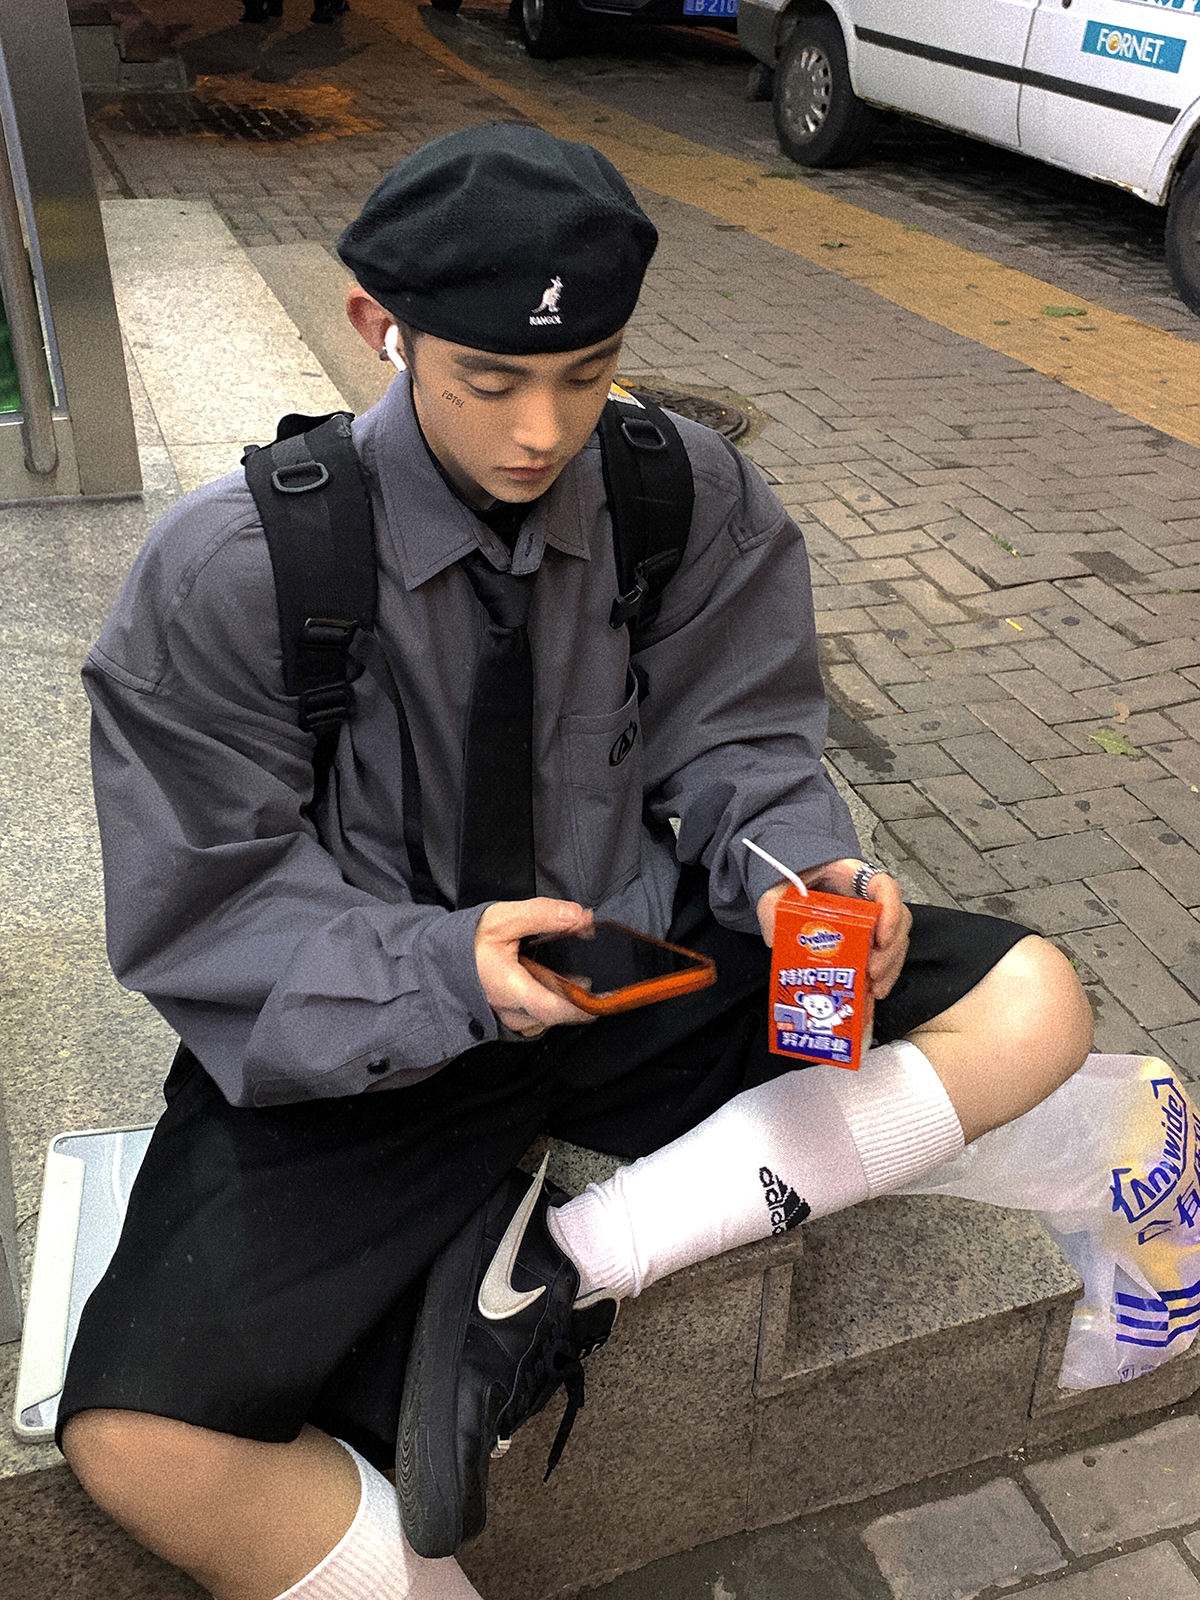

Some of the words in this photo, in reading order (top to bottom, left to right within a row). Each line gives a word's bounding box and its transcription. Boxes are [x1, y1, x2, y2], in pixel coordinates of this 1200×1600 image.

[1096, 28, 1165, 63] FORNET
[779, 967, 856, 989] 特浓可可
